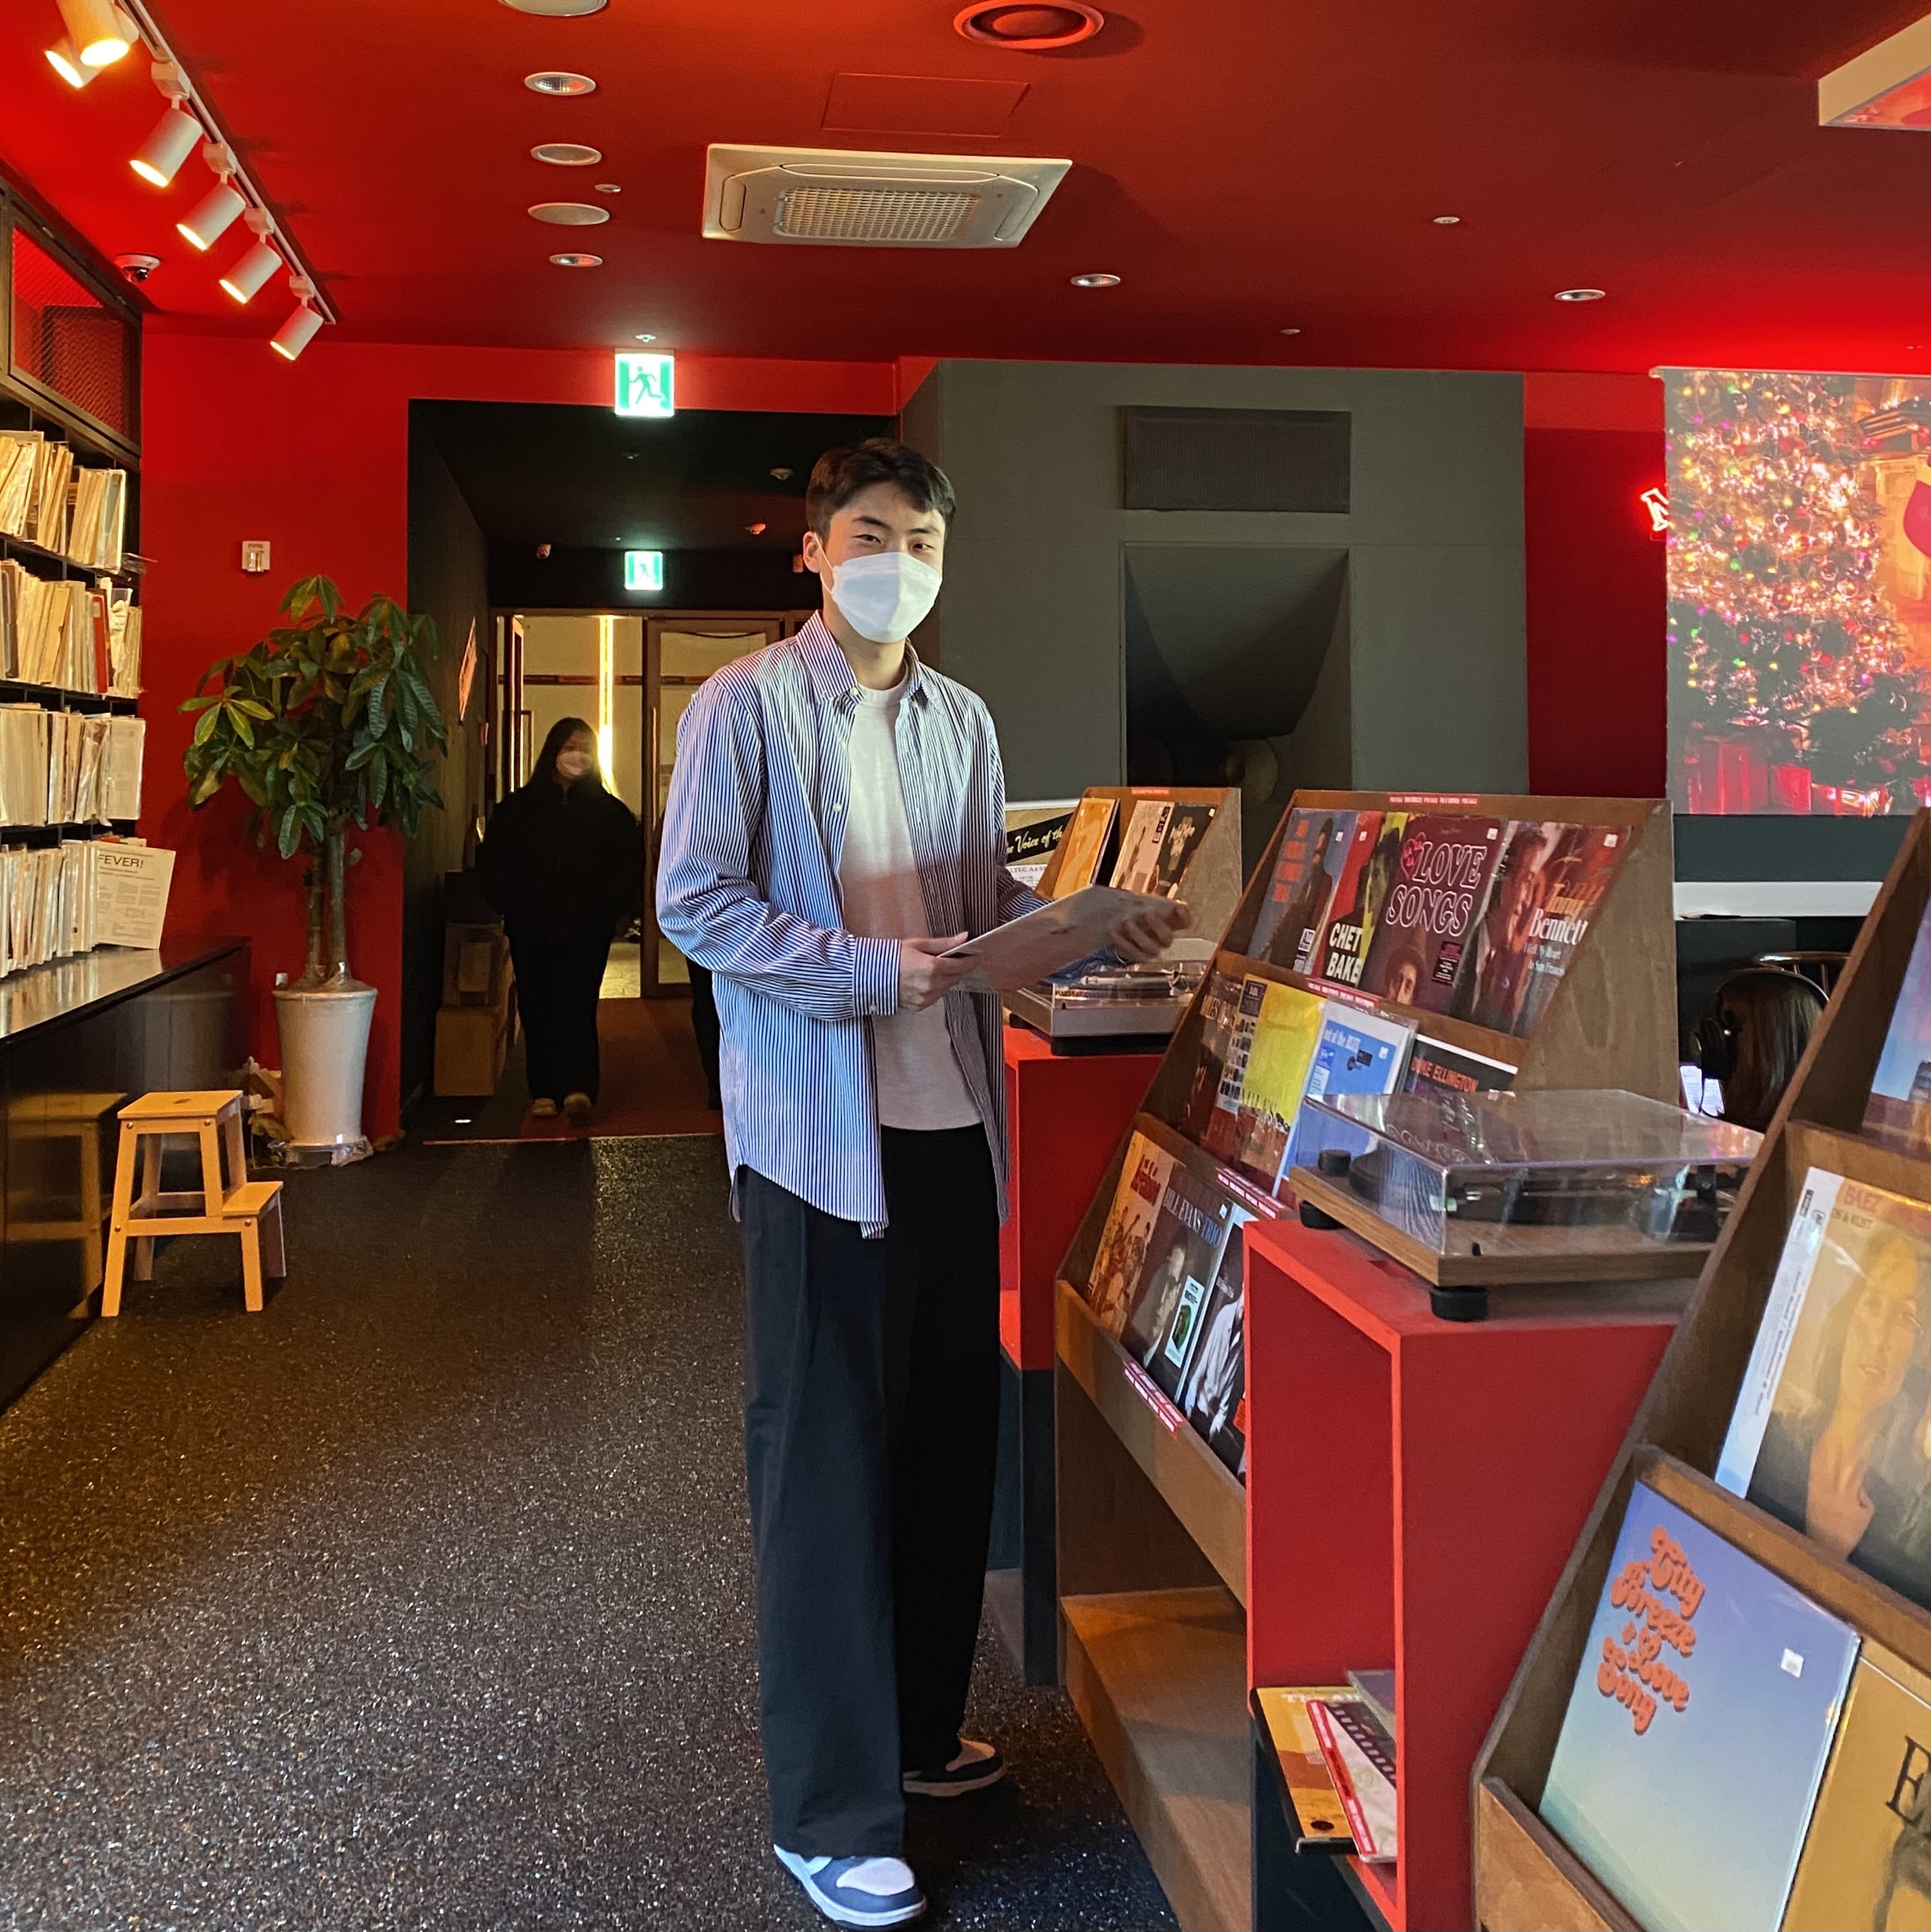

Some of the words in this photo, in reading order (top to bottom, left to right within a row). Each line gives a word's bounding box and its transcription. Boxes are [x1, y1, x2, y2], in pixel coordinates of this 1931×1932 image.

[99, 854, 144, 869] FEVER!
[1015, 830, 1039, 853] Voice
[1041, 830, 1052, 848] of
[1412, 841, 1487, 889] LOVE
[1386, 884, 1473, 936] SONGS
[1528, 907, 1589, 945] Bennett
[1329, 923, 1363, 952] CHET
[1162, 1187, 1180, 1216] BILL
[1178, 1198, 1204, 1234] EVANS
[1201, 1216, 1223, 1248] TRIO
[1597, 1636, 1657, 1736] Song
